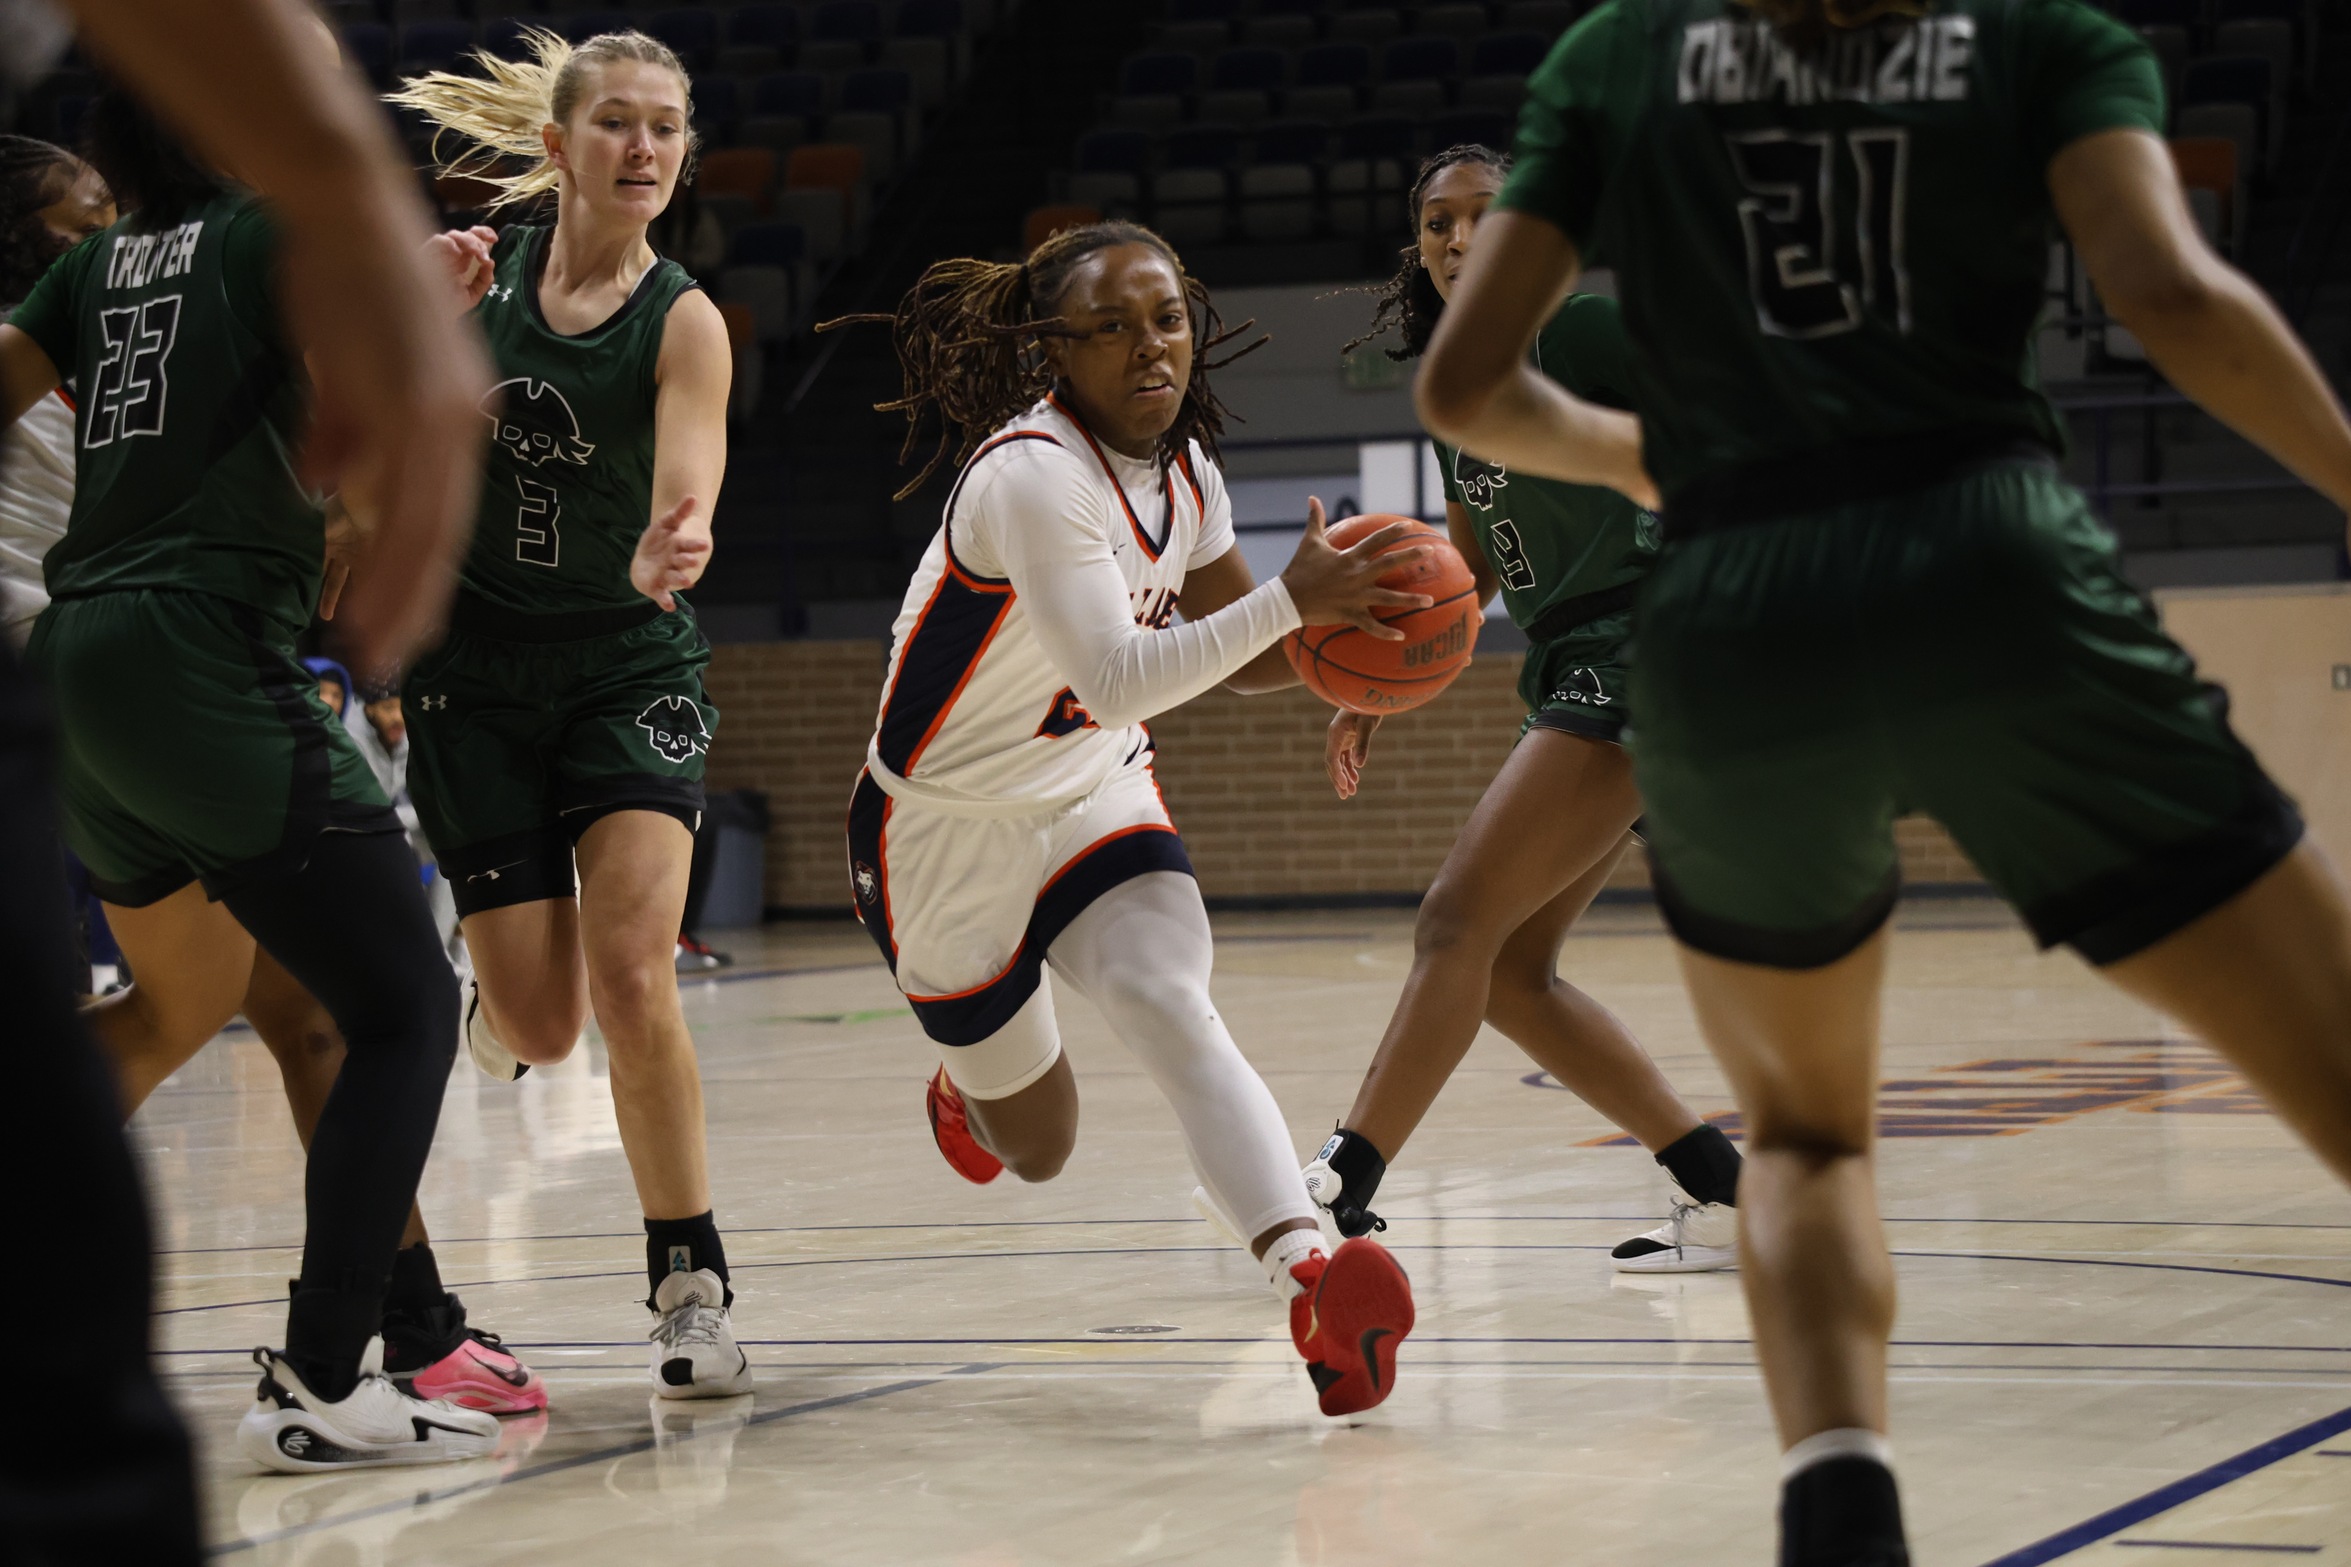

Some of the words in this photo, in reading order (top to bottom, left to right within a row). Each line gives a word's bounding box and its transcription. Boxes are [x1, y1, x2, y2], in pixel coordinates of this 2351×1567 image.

[1723, 127, 1913, 338] 21
[84, 294, 183, 449] 23
[515, 474, 561, 568] 3
